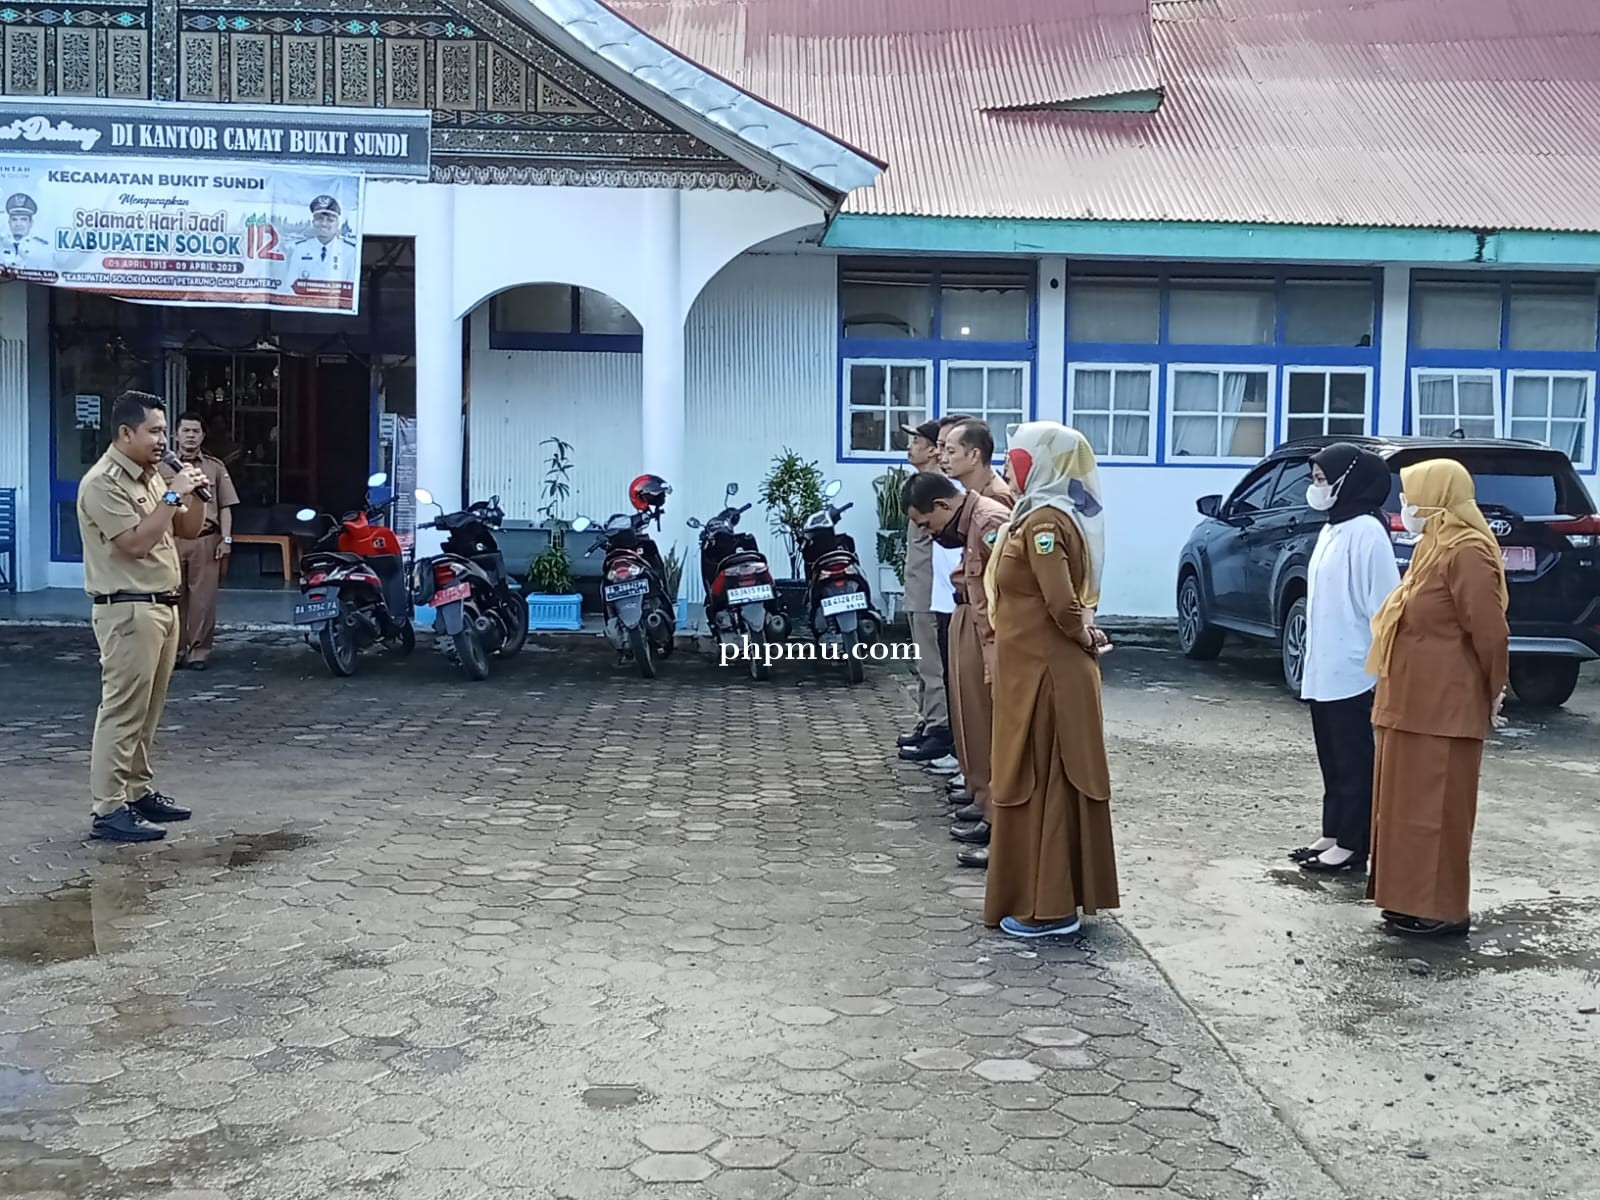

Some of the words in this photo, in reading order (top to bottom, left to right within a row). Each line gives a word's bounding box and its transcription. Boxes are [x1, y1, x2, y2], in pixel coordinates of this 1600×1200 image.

[111, 123, 134, 146] DI
[139, 124, 218, 150] KANTOR
[223, 127, 284, 152] CAMAT
[289, 129, 349, 154] BUKIT
[354, 133, 409, 157] SUNDI
[48, 170, 154, 186] KECAMATAN
[158, 174, 209, 188] BUKIT
[213, 176, 265, 190] SUNDI
[118, 193, 190, 208] Mengucapkan
[75, 211, 145, 230] Selamat
[148, 212, 184, 231] Hari
[187, 213, 225, 232] Jadi
[57, 230, 169, 253] KABUPATEN
[175, 234, 242, 256] SOLOK
[122, 260, 148, 269] APRIL
[175, 261, 187, 270] 09
[189, 262, 214, 271] APRIL
[112, 274, 139, 283] SOLOK
[141, 275, 174, 285] BANGKIT
[217, 278, 235, 287] DAN
